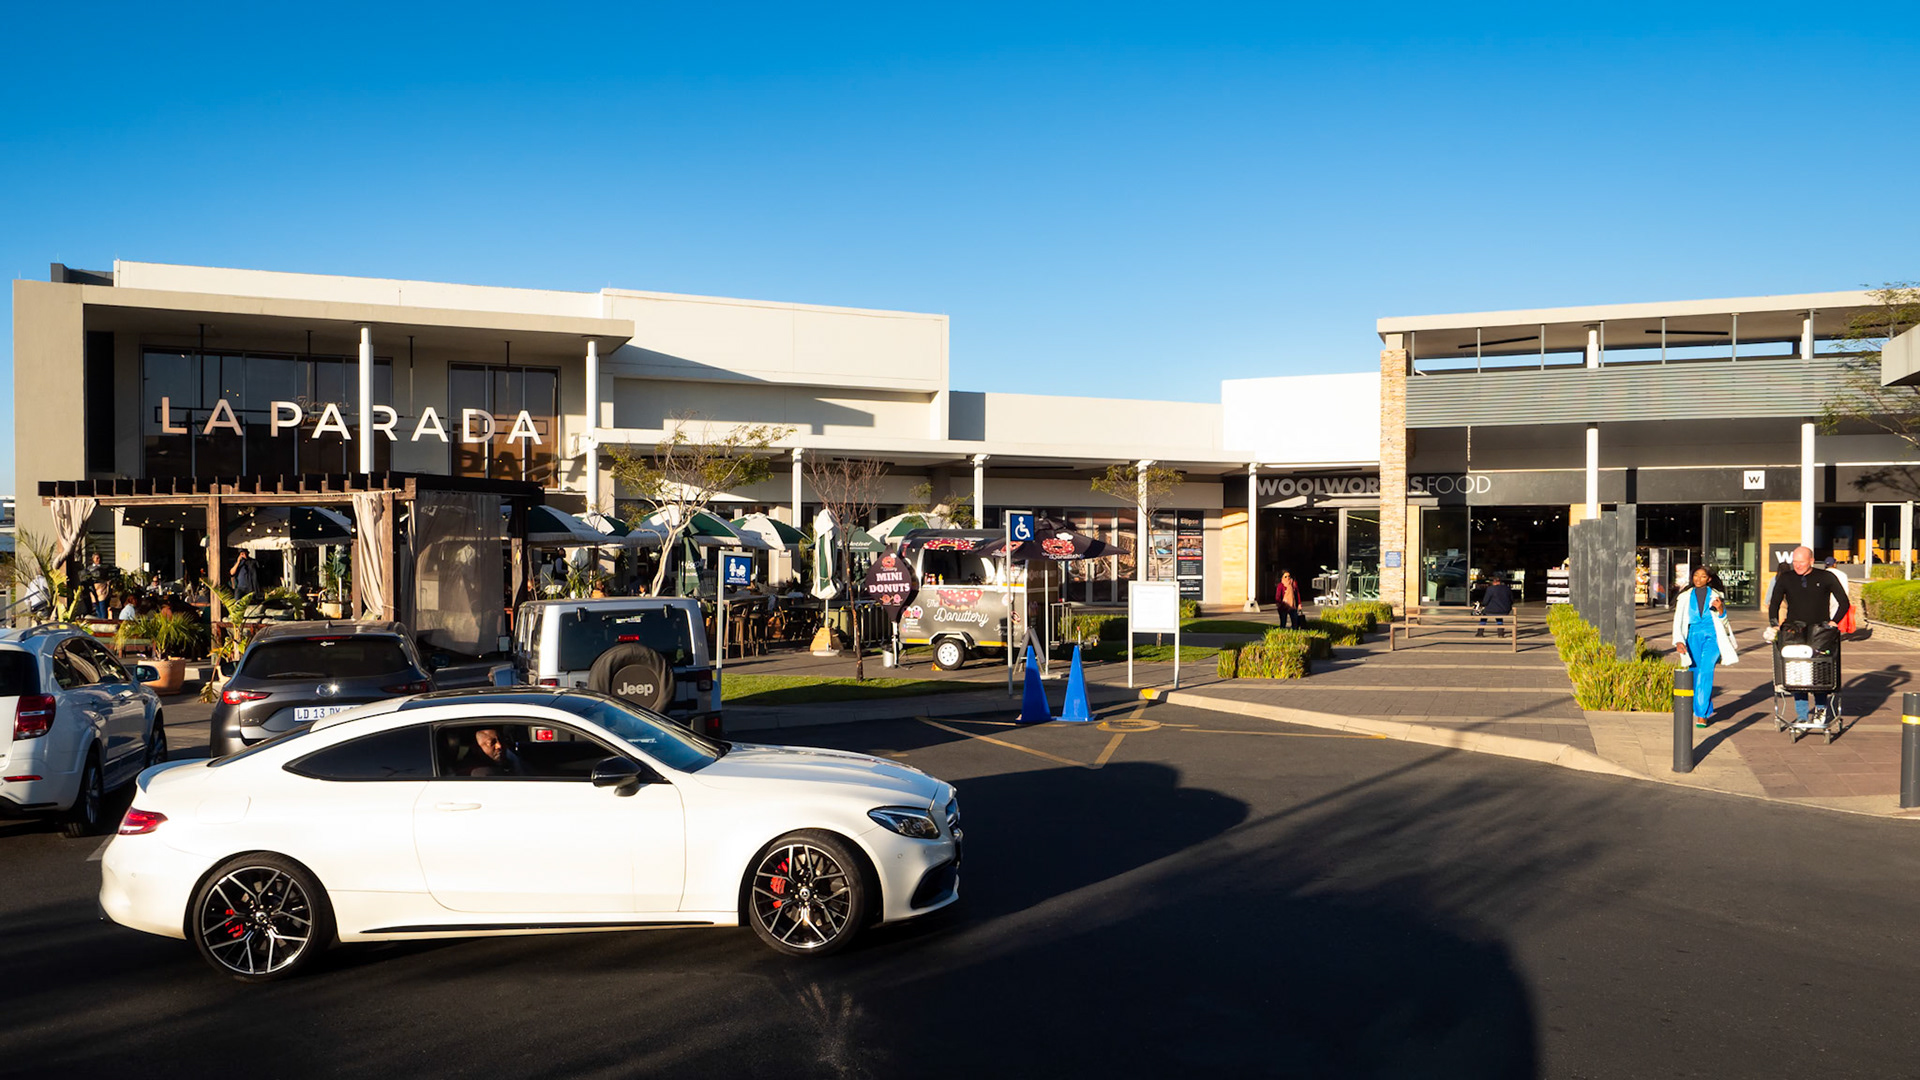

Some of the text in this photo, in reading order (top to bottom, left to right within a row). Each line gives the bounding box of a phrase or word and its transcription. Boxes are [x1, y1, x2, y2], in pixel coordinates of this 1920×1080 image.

[161, 396, 244, 436] LA
[270, 401, 542, 445] PARADA
[1257, 476, 1490, 496] WOOLWORS FOOD
[1748, 476, 1760, 484] W
[876, 572, 903, 582] MINI
[869, 583, 910, 593] DONUTS
[934, 607, 989, 627] Donuttery
[617, 682, 654, 696] Jeep
[297, 709, 309, 720] LD
[313, 708, 325, 718] 13
